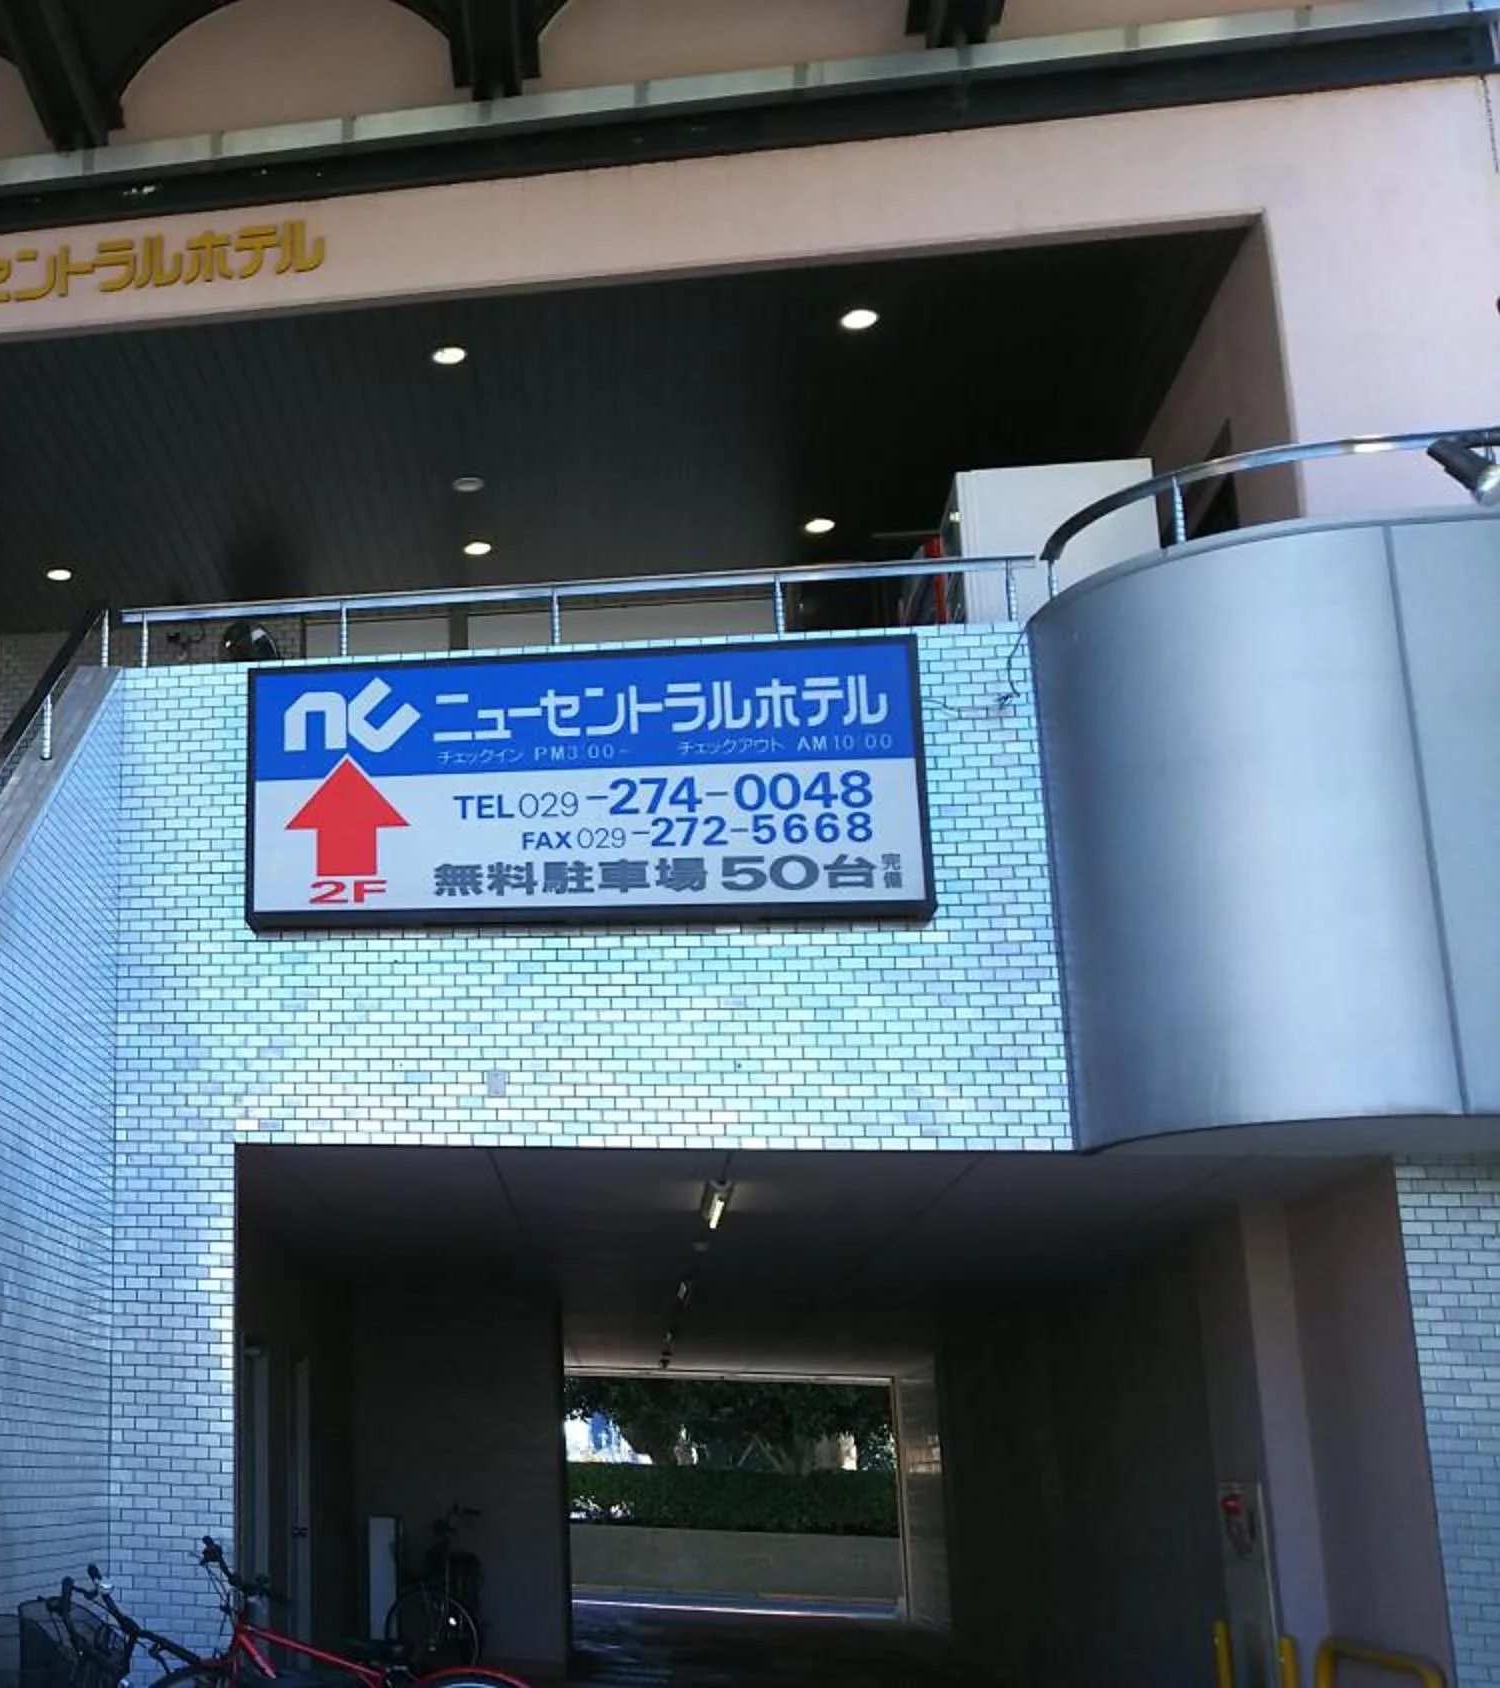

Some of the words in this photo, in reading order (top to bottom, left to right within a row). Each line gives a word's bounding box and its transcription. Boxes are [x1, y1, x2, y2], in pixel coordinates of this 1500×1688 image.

[433, 673, 888, 743] ニューセントラルホテル
[437, 748, 526, 766] チェックイン
[677, 736, 784, 756] チェックアウト
[309, 879, 388, 905] 2F
